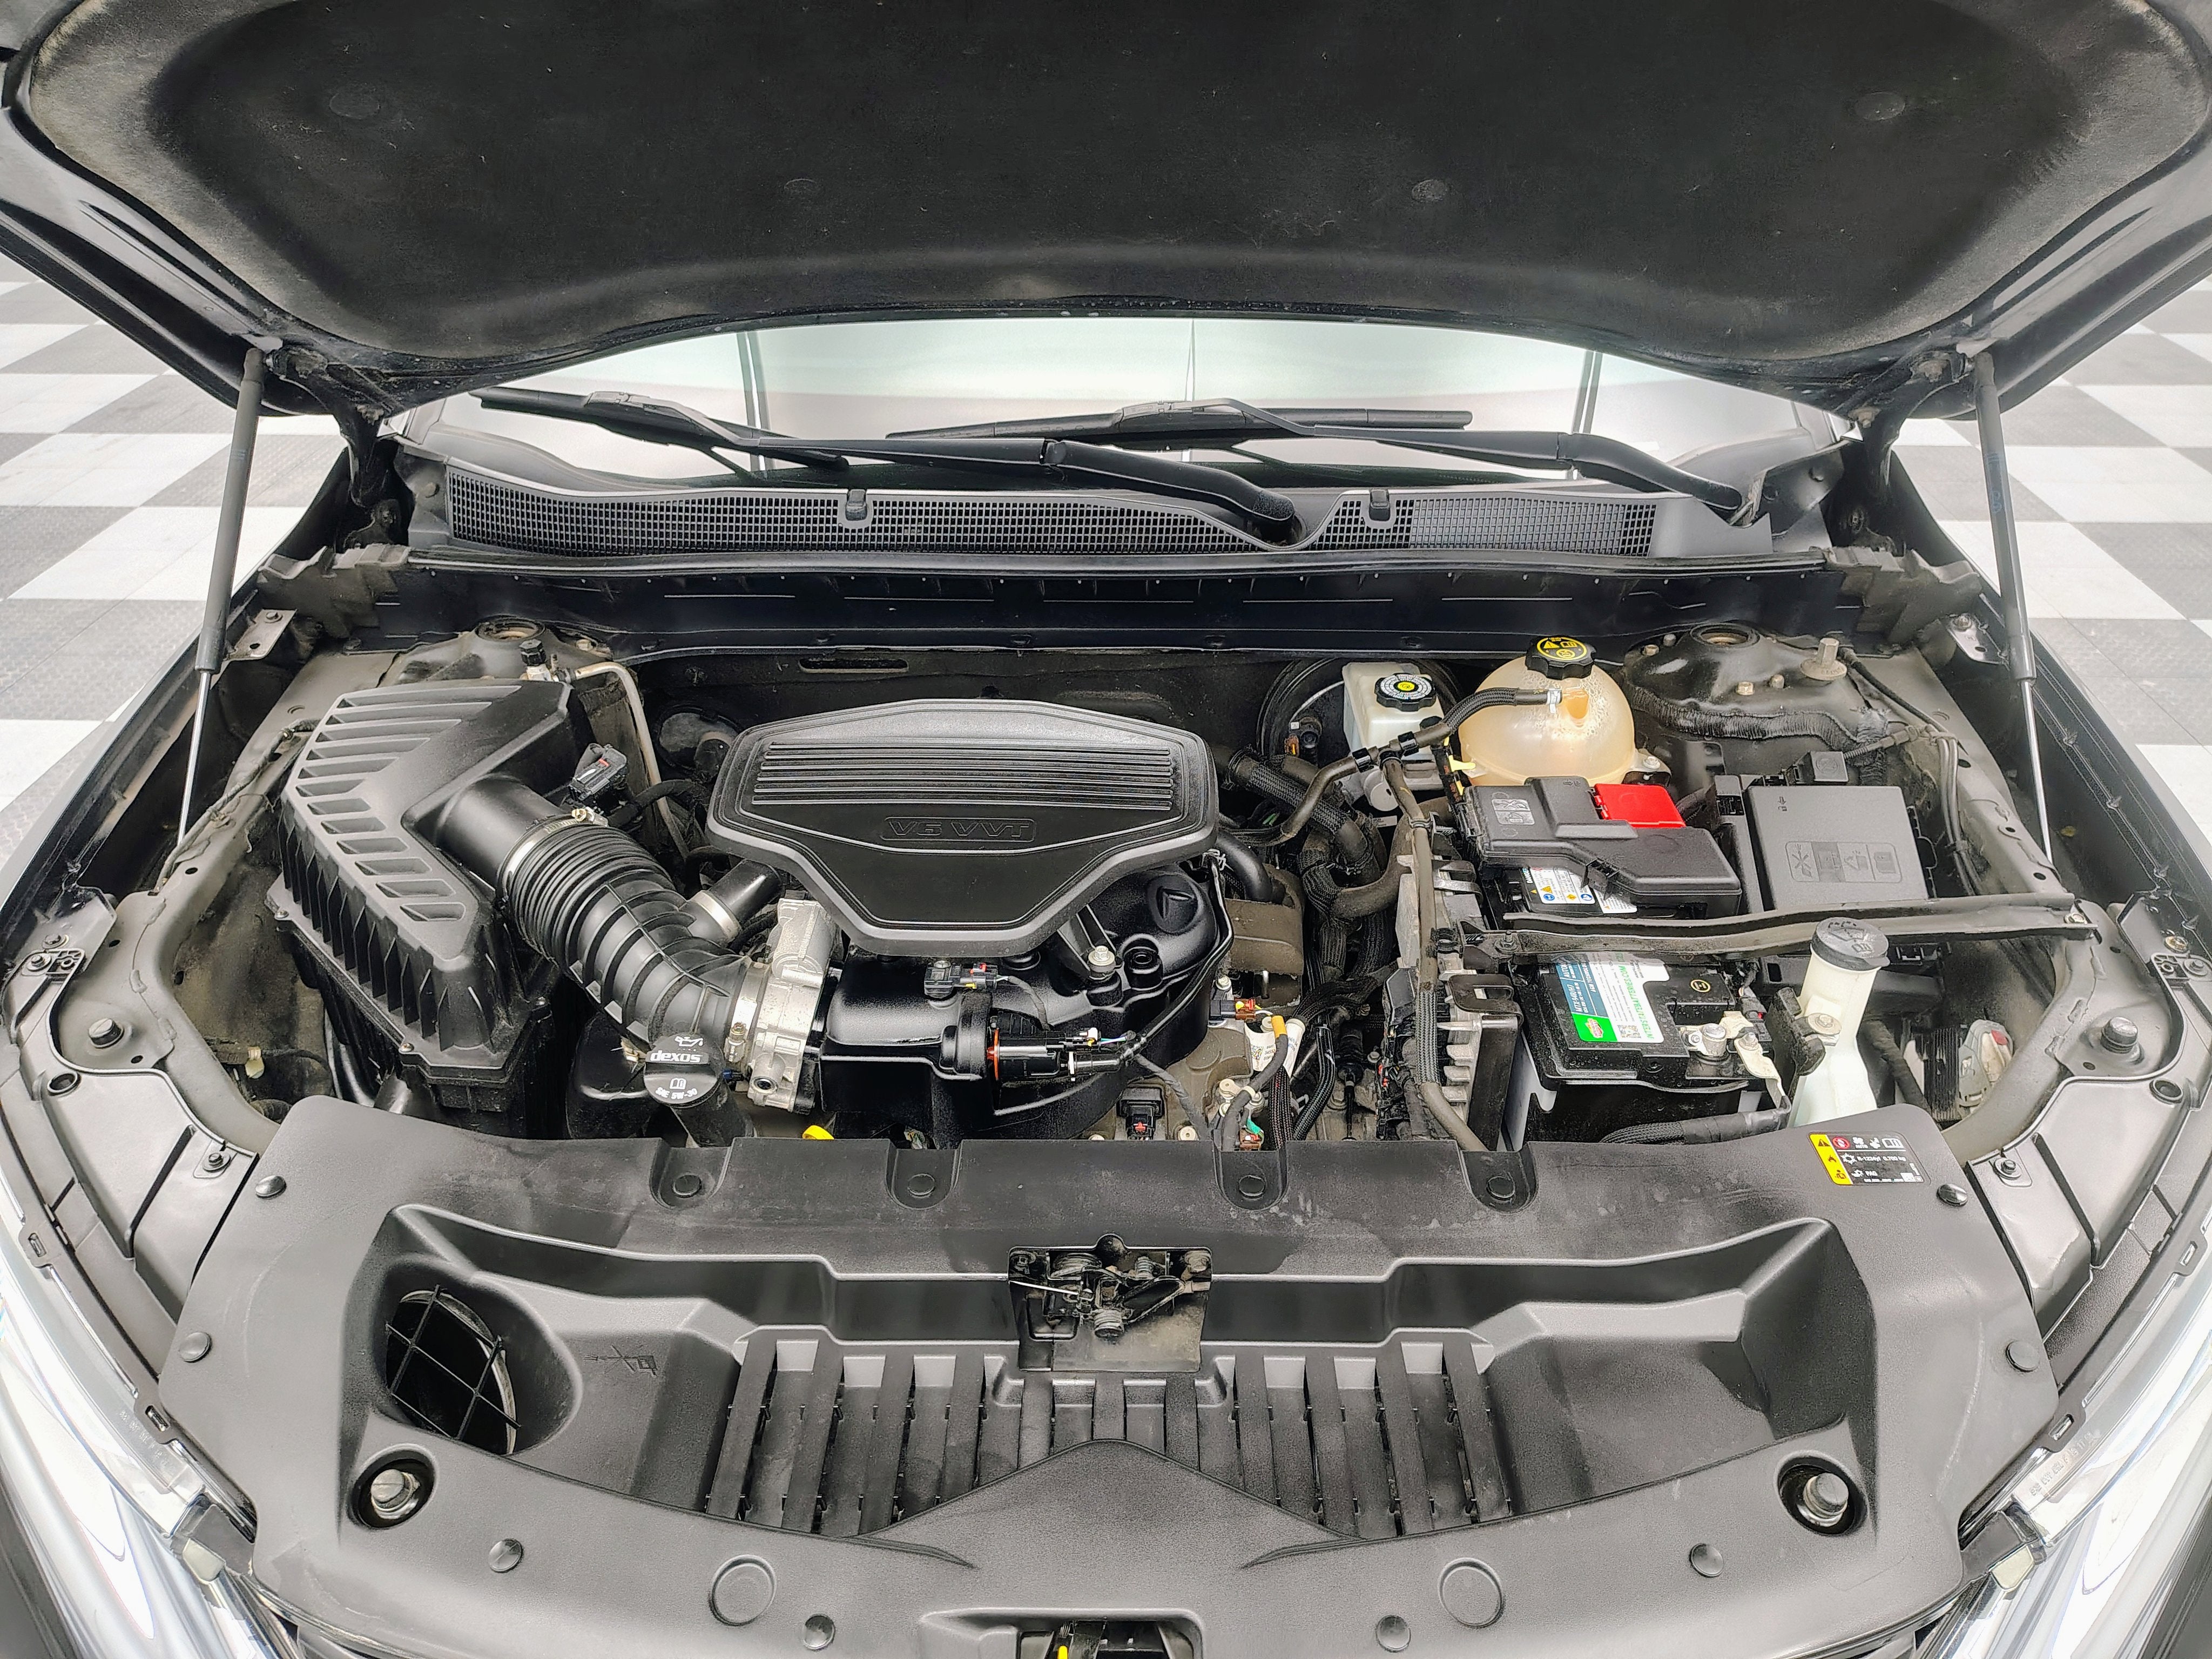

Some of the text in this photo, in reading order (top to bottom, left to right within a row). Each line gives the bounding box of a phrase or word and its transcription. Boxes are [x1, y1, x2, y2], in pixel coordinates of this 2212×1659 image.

[889, 821, 1029, 837] V6 VVT
[650, 1050, 703, 1063] dexos
[671, 1088, 698, 1100] 5W-30
